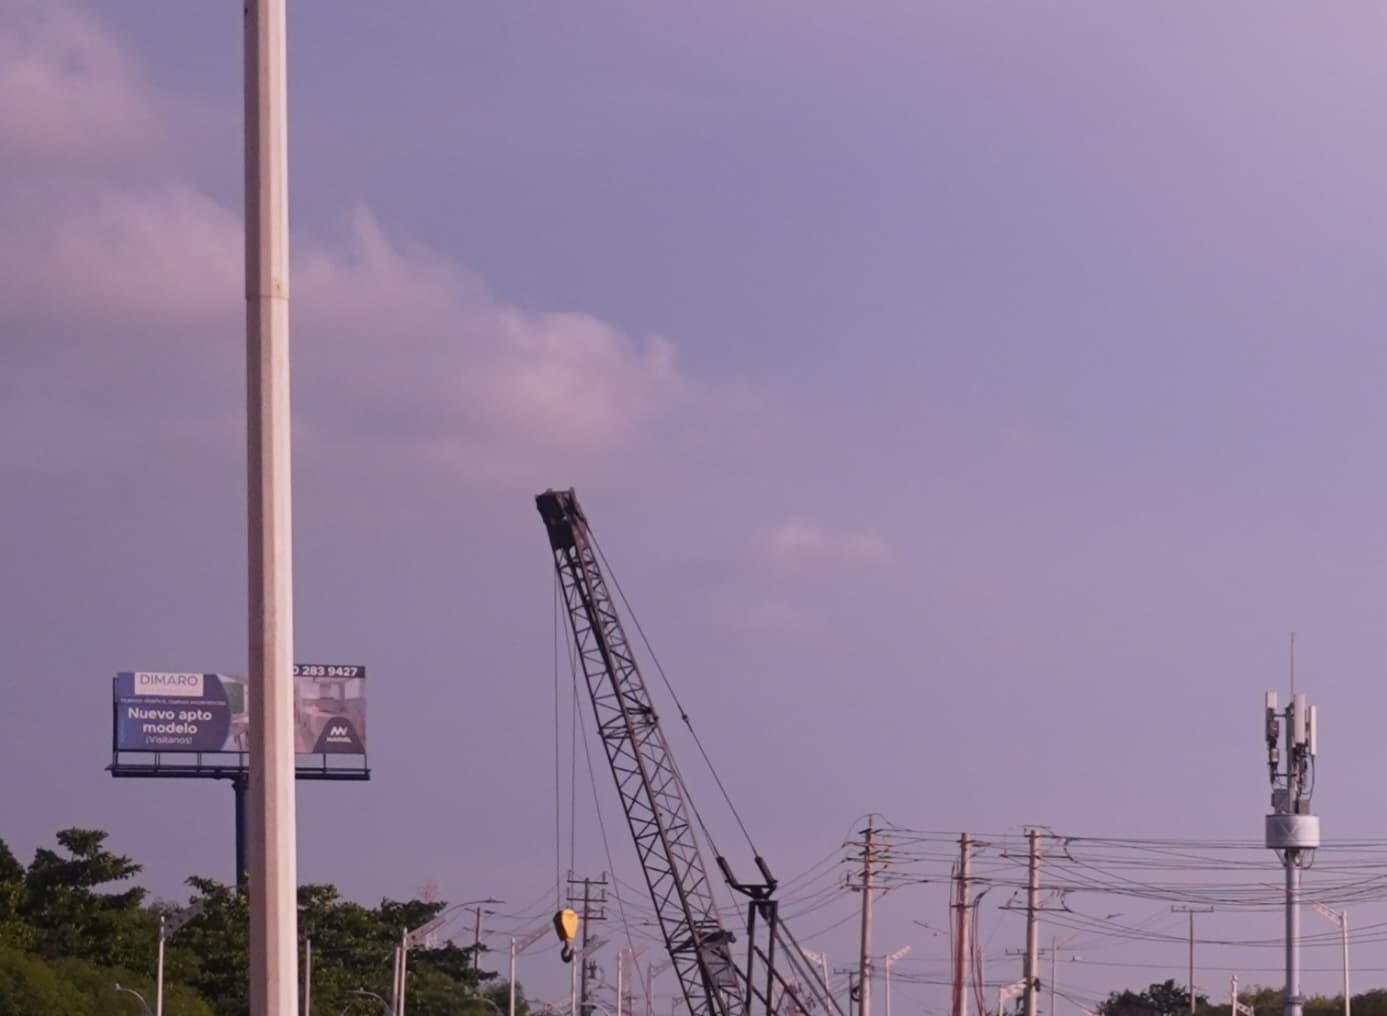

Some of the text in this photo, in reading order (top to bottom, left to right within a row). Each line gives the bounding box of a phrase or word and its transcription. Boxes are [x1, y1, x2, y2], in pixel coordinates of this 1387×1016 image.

[302, 666, 325, 676] 283
[328, 666, 358, 677] 9427
[140, 674, 199, 686] DIMARO
[128, 707, 212, 723] Nuevo apto
[143, 722, 198, 734] modelo
